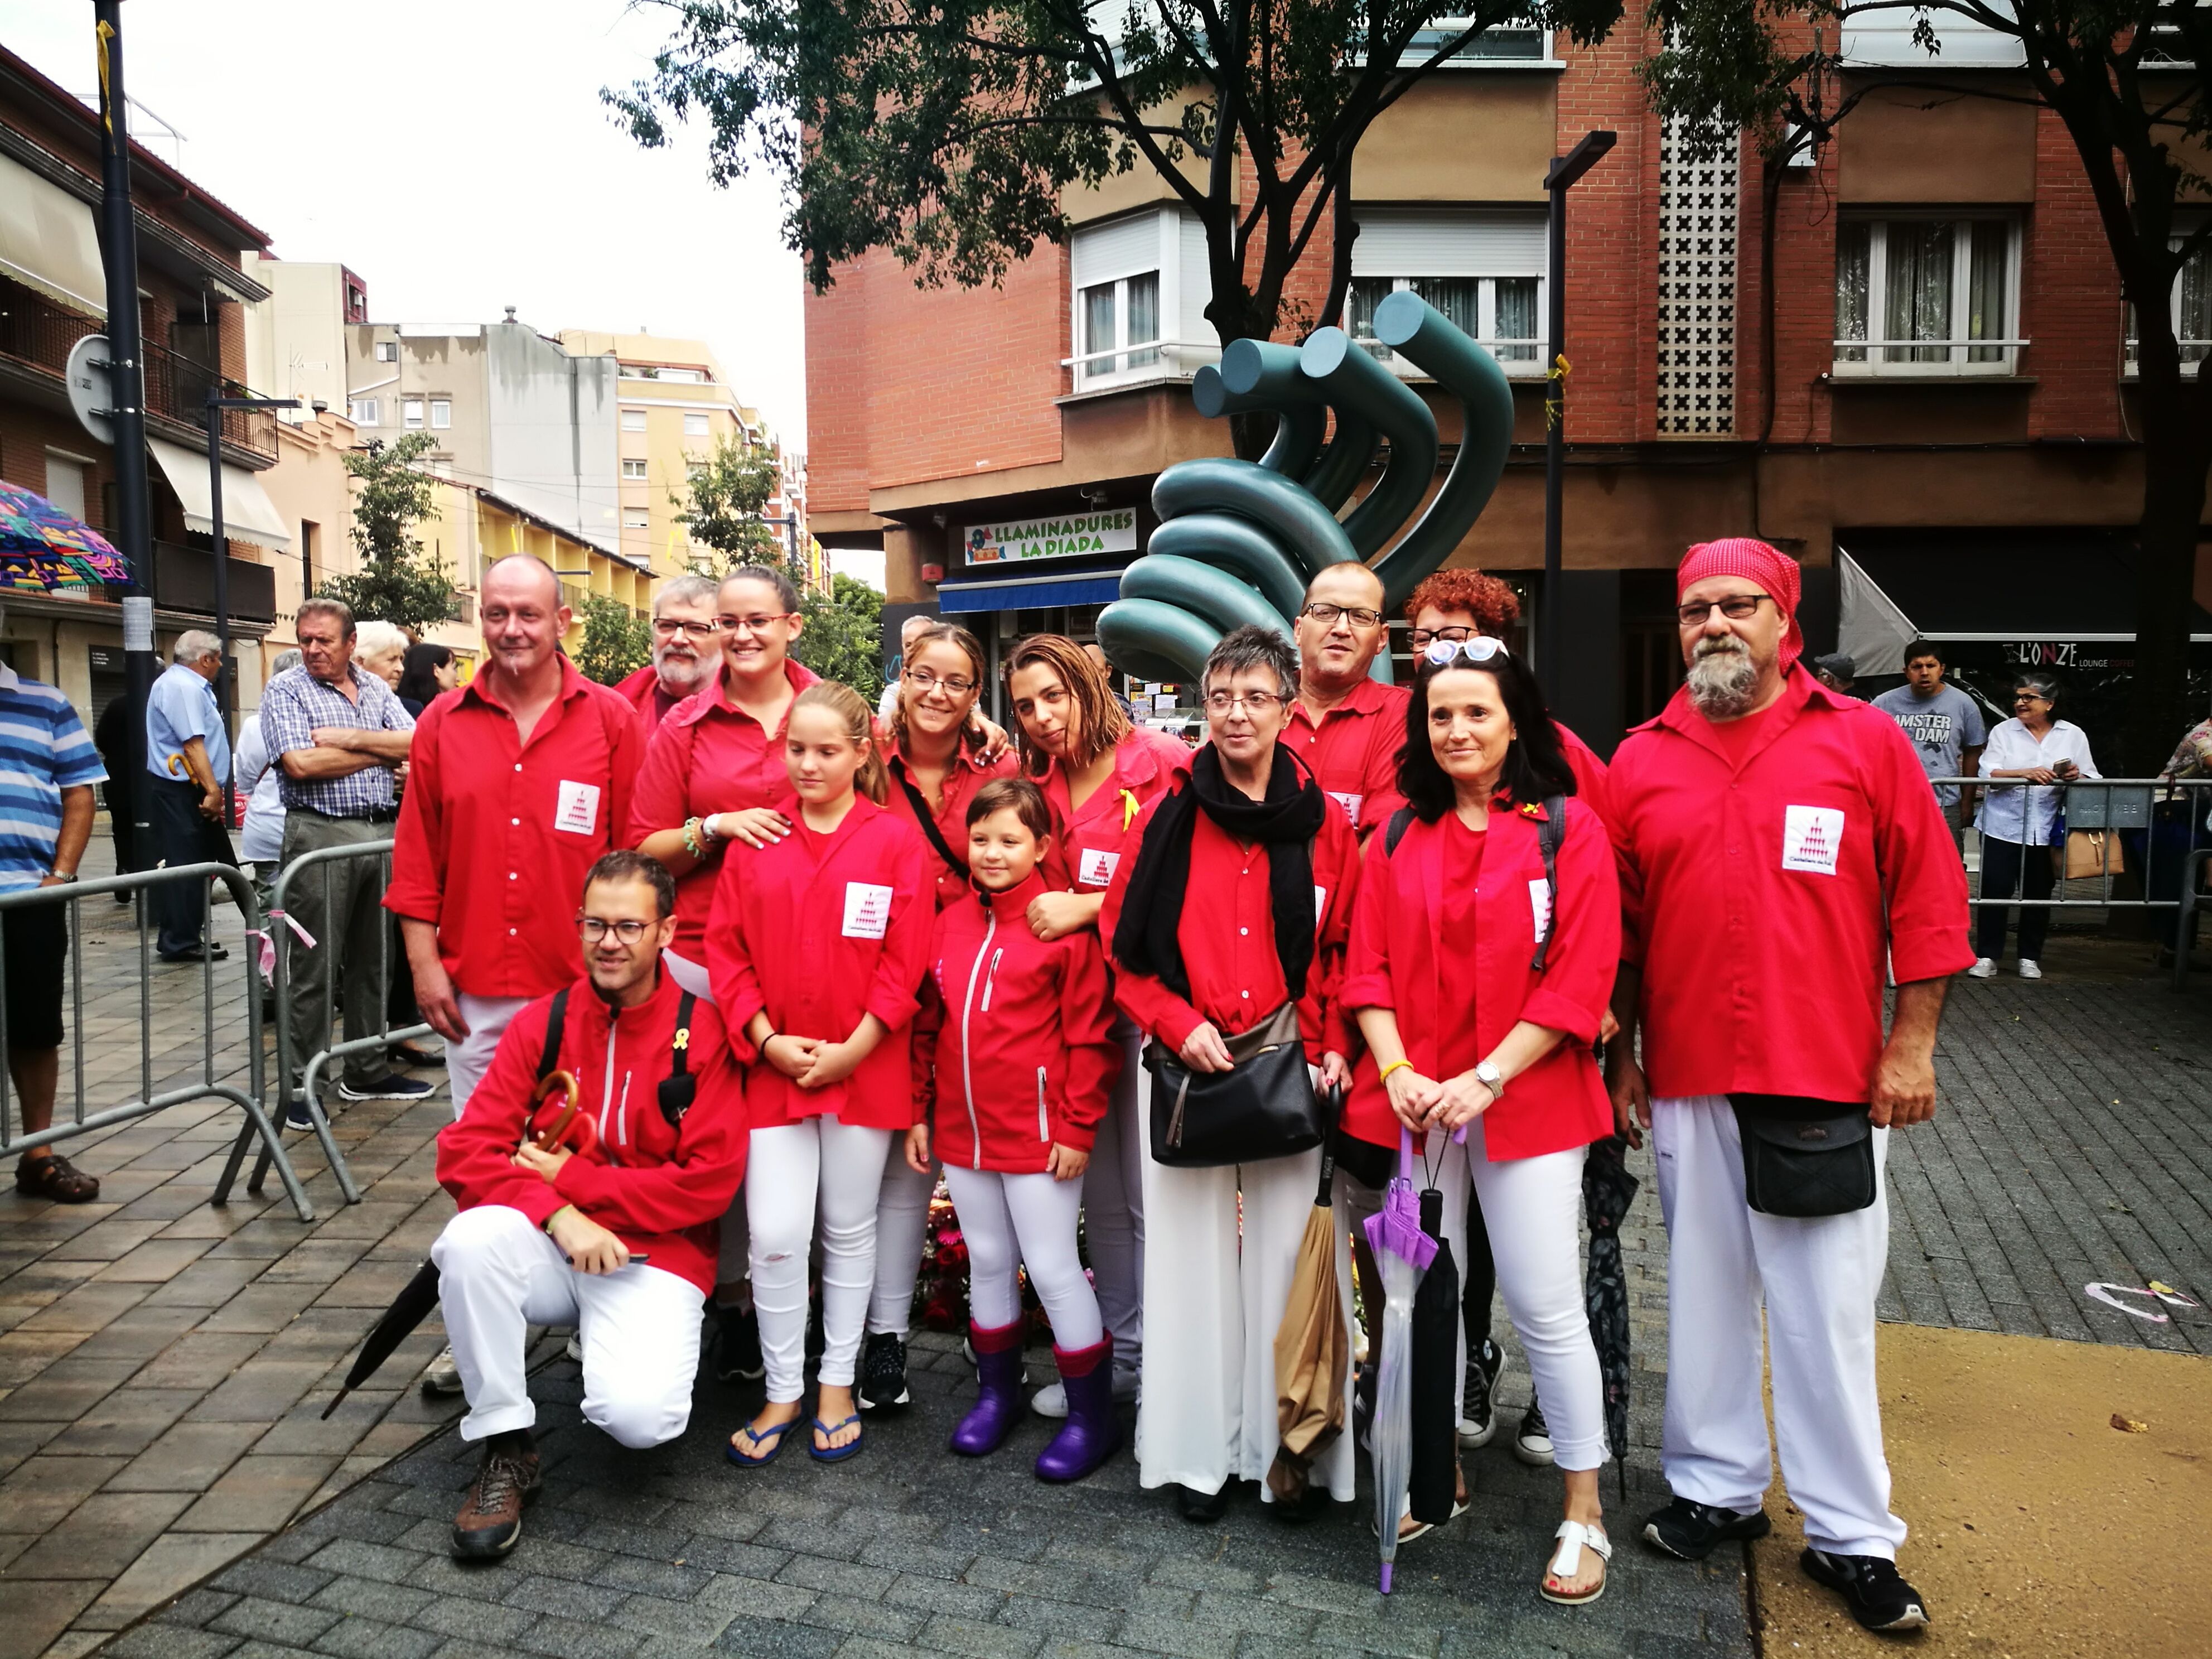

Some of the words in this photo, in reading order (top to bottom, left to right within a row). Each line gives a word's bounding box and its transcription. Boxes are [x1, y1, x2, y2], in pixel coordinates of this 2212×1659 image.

[995, 512, 1133, 543] LLAMINADURES
[1021, 542, 1042, 558] LA
[1045, 534, 1104, 556] DIADA
[2020, 642, 2077, 667] L'ONZE
[1894, 714, 1952, 730] AMSTER
[1915, 727, 1950, 743] DAM
